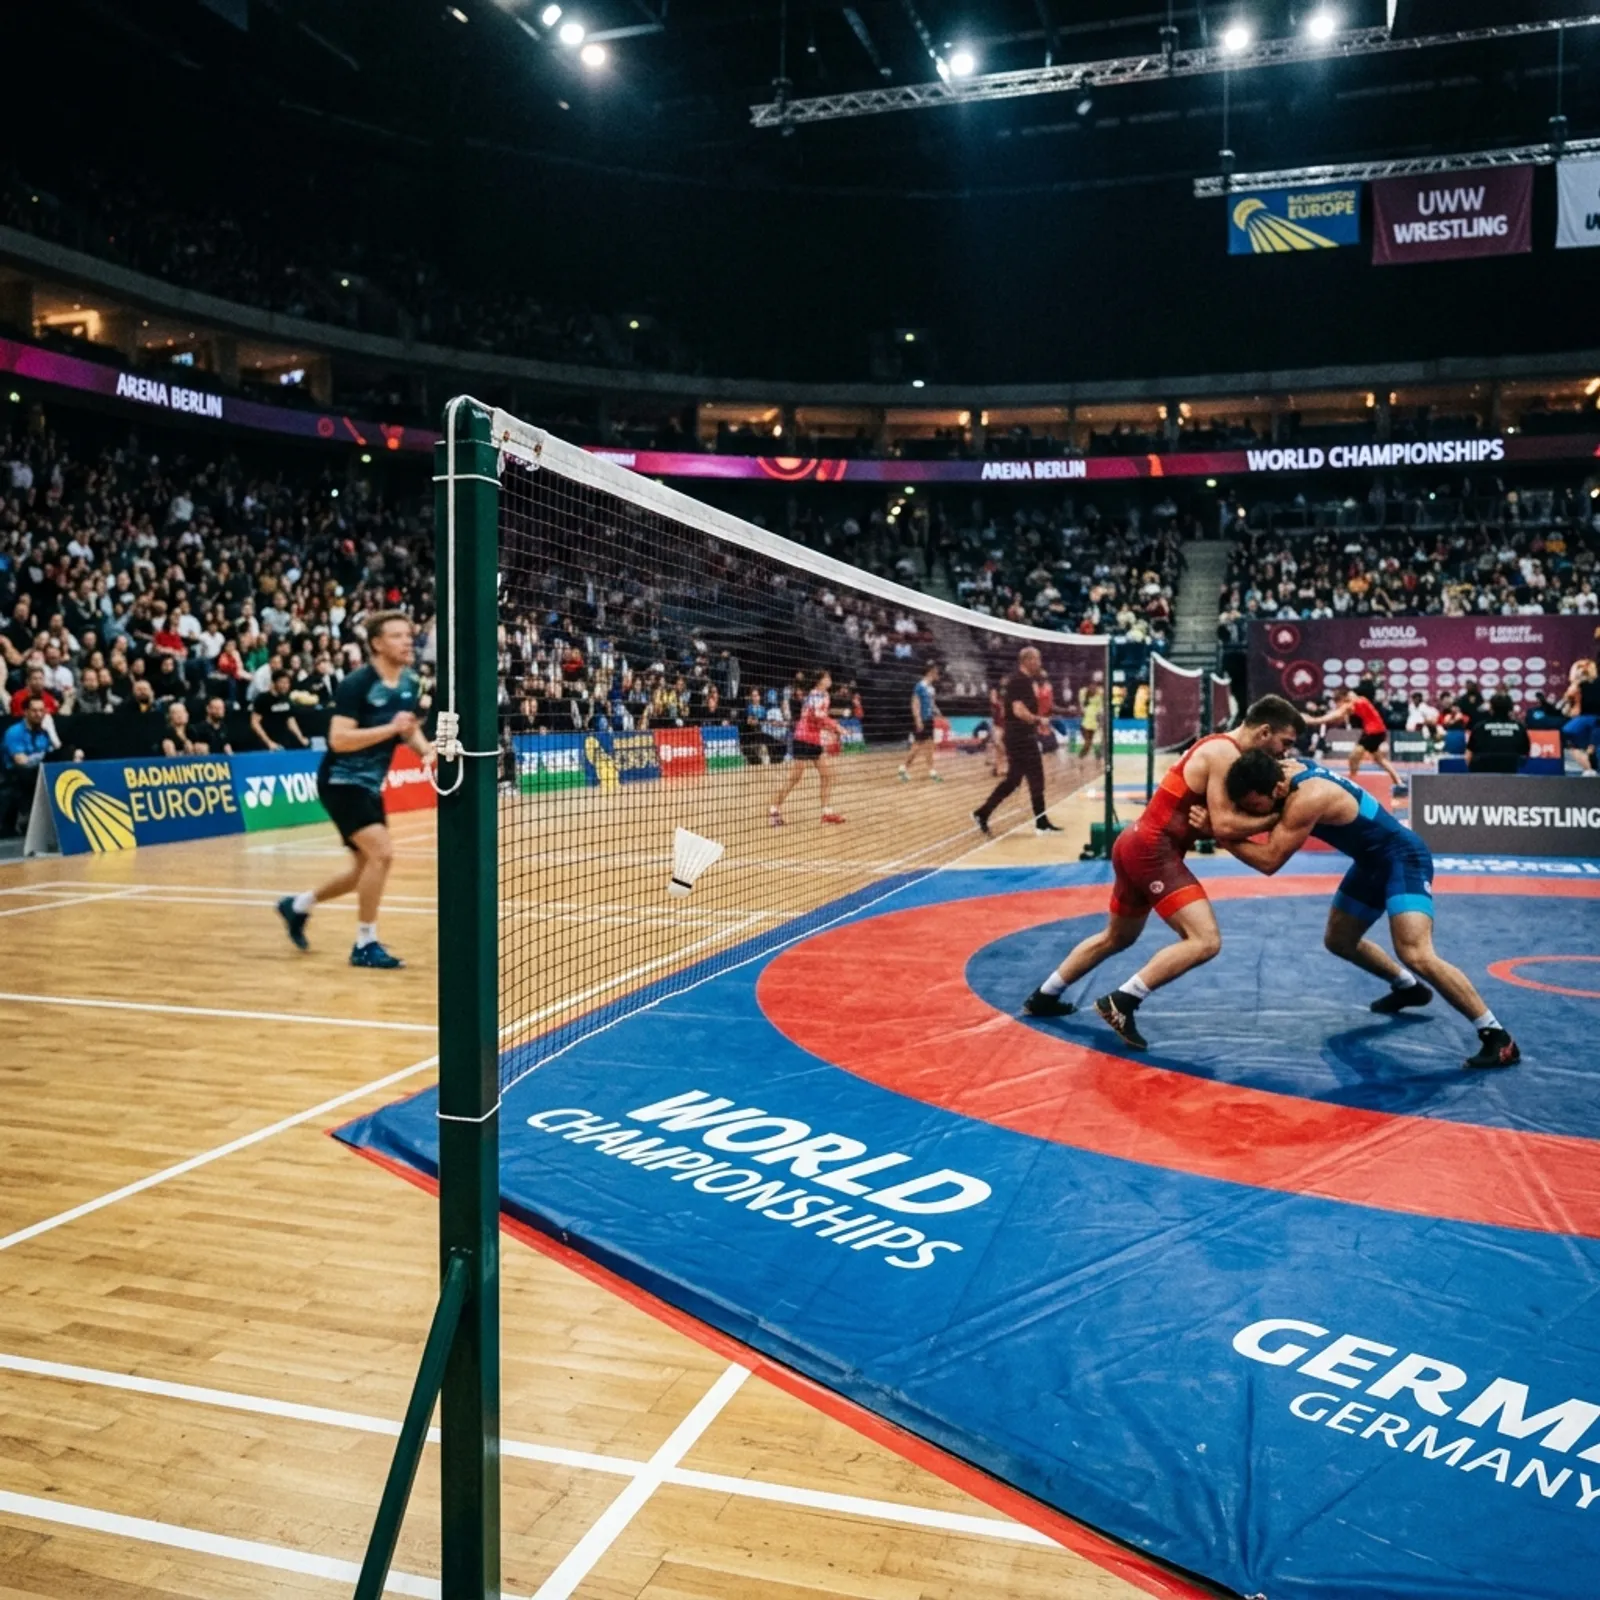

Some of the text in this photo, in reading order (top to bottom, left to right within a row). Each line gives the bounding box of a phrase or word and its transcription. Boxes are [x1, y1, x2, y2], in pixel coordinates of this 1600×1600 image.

[1288, 200, 1355, 220] EUROPE
[1418, 186, 1486, 216] UWW
[1393, 214, 1509, 244] WRESTLING
[116, 372, 223, 419] ARENA BERLIN
[981, 459, 1087, 480] ARENA BERLIN
[1247, 438, 1505, 471] WORLD CHAMPIONSHIPS
[123, 762, 231, 789] BADMINTON
[278, 771, 319, 804] YON
[130, 784, 238, 822] EUROPE
[1423, 804, 1600, 828] UWW WRESTLING
[625, 1089, 992, 1214] WORLD
[526, 1108, 963, 1269] CHAMPIONSHIPS
[1289, 1391, 1600, 1509] GERMANY
